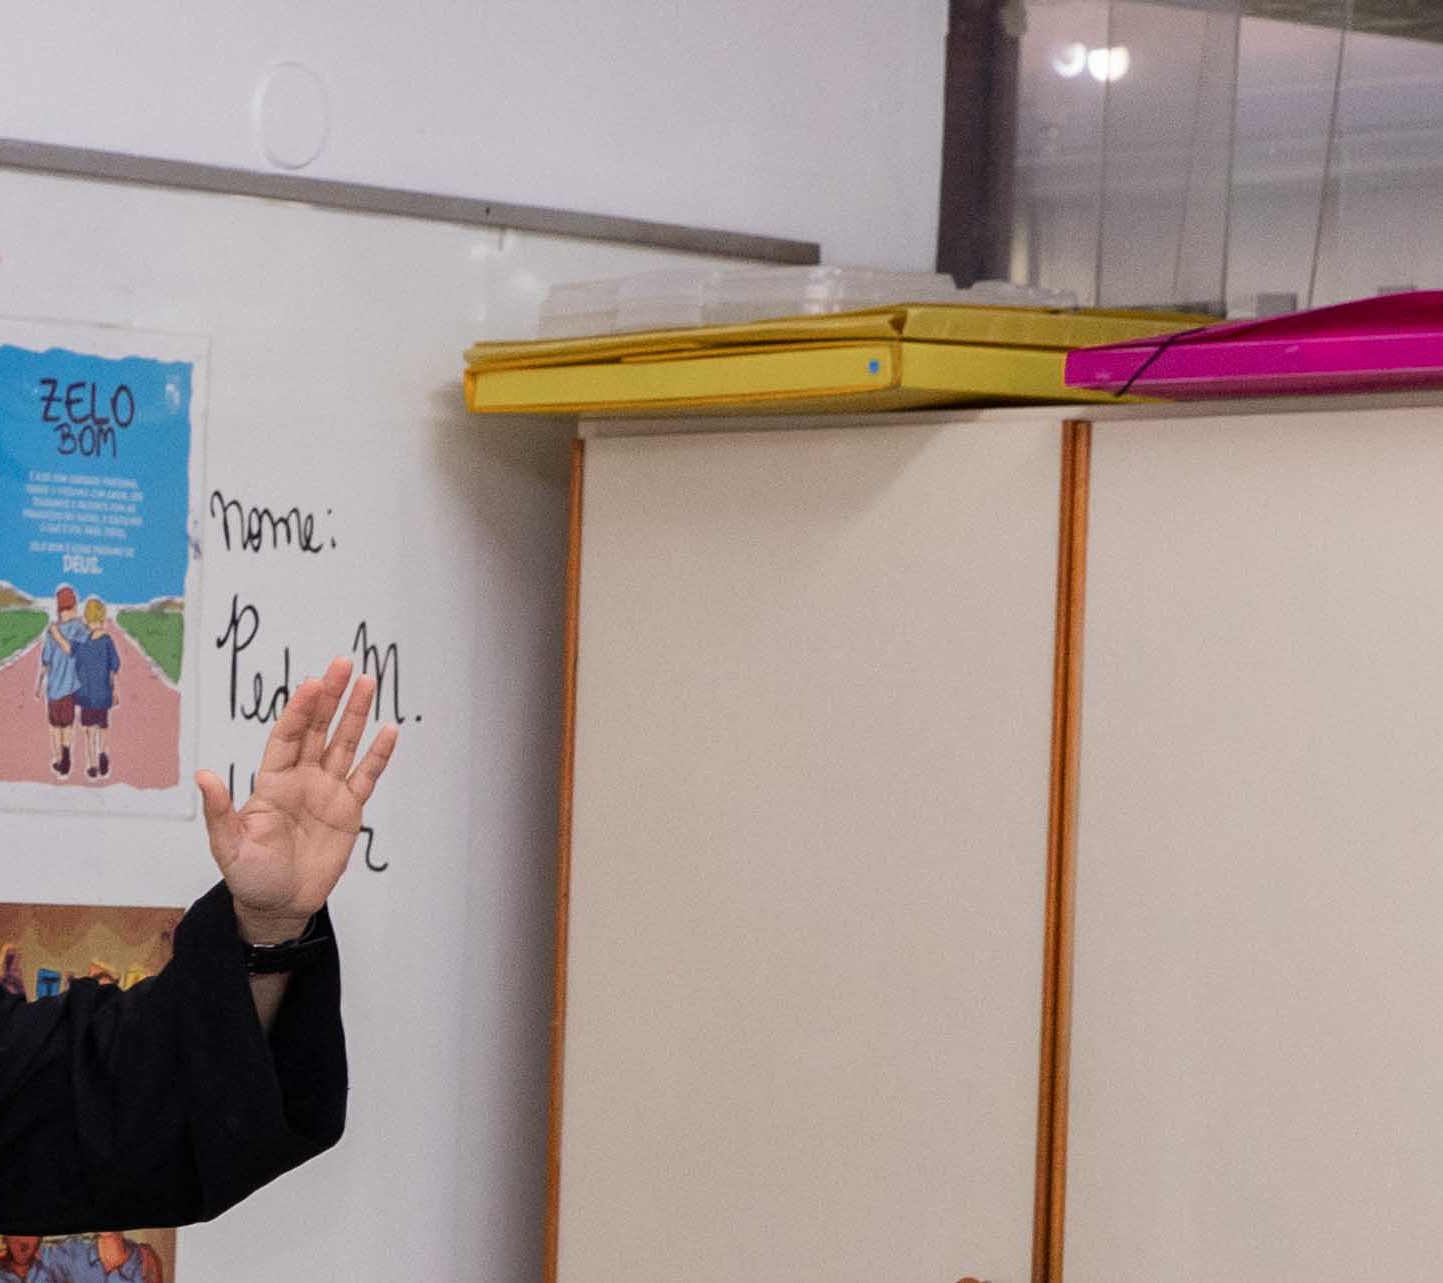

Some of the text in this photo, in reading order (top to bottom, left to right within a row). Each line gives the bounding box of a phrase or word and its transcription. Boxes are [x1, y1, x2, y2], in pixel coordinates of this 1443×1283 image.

[40, 378, 135, 428] ZELO
[54, 423, 118, 459] BOM
[216, 594, 300, 723] Ped
